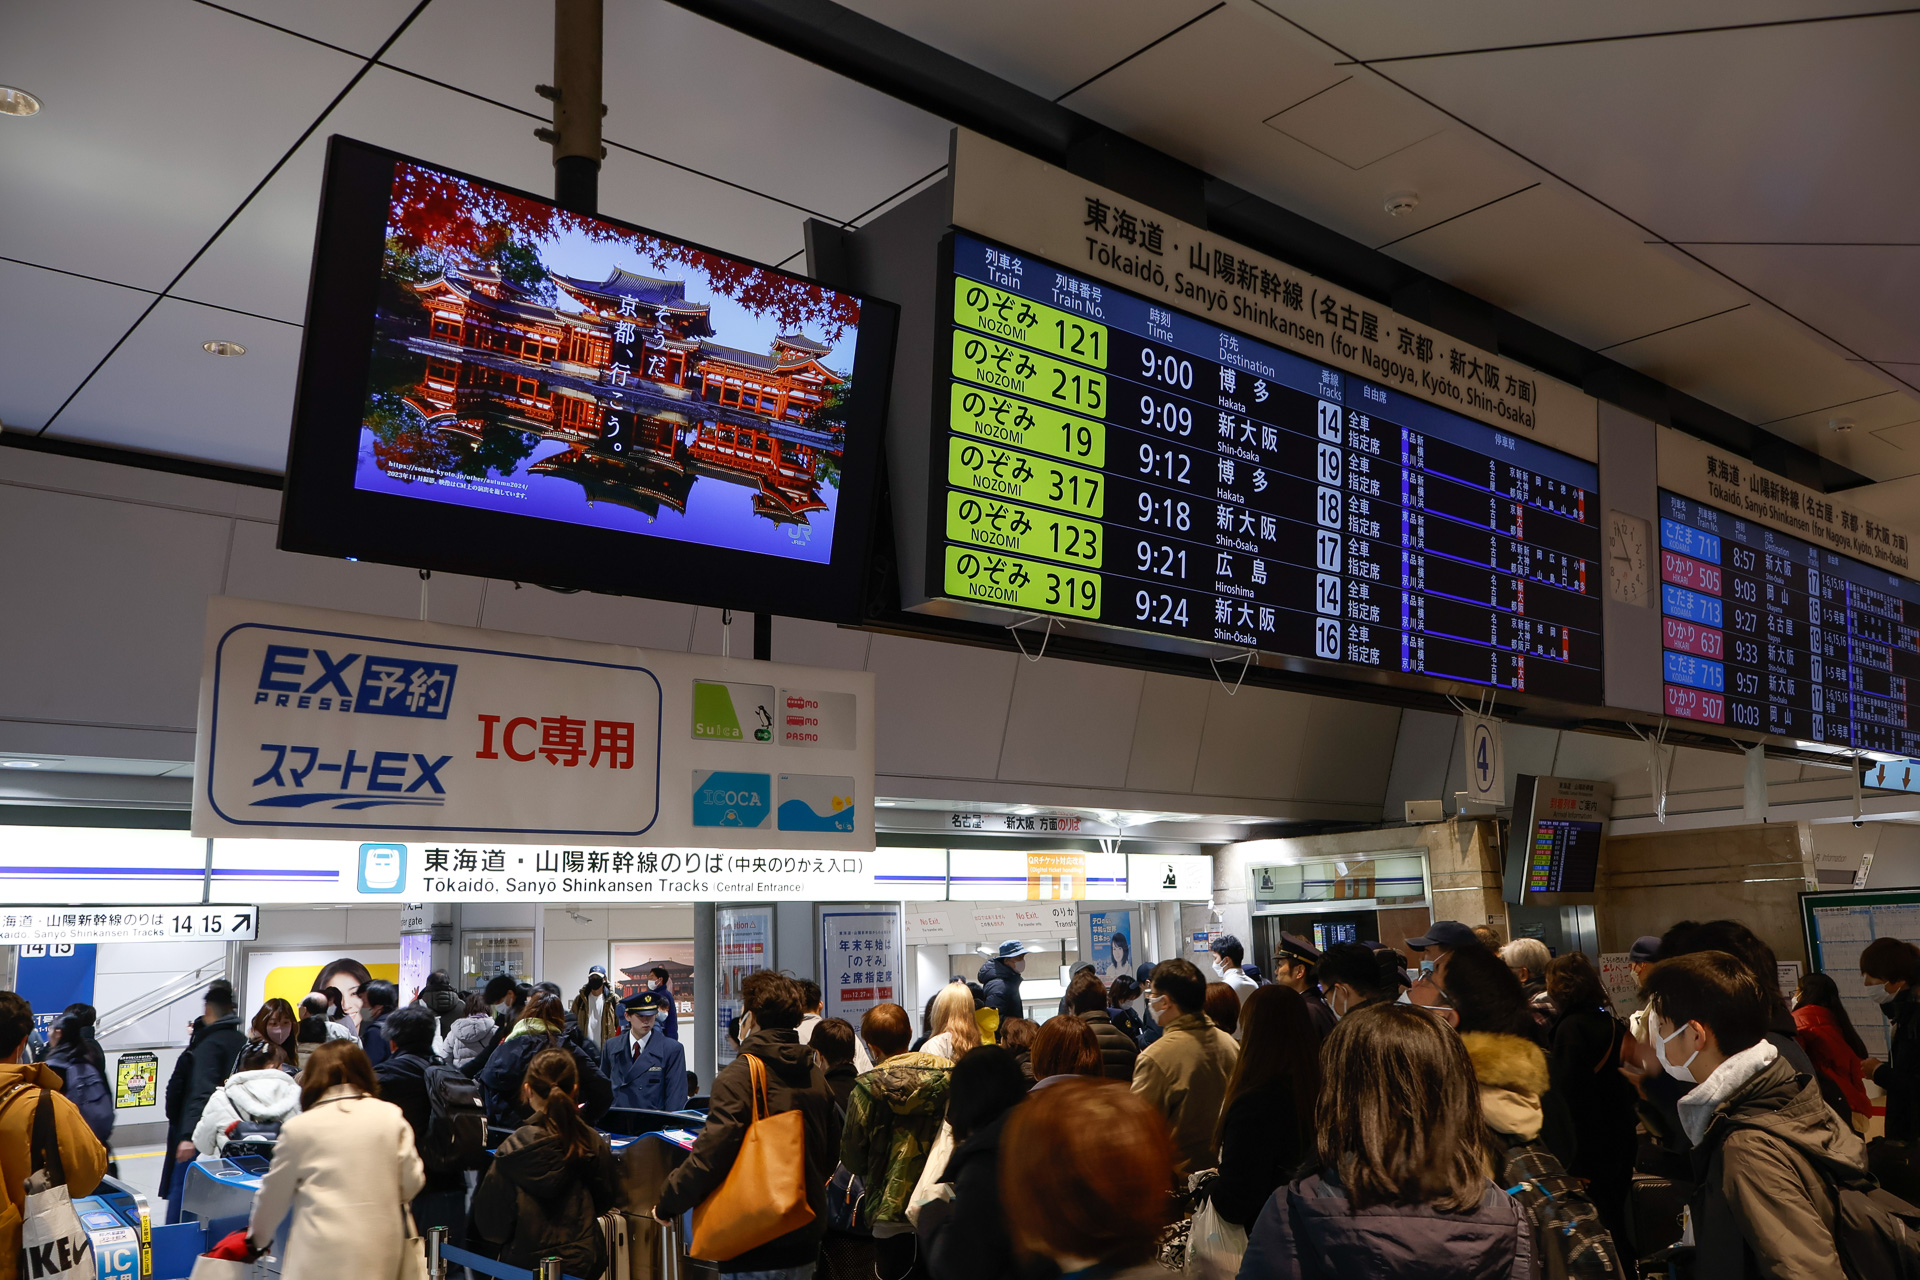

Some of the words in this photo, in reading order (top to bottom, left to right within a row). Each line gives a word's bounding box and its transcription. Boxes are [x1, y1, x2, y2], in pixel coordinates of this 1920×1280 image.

[985, 248, 1023, 276] 列車名
[987, 265, 1020, 290] Train
[1055, 274, 1102, 302] 列車番号
[966, 287, 1039, 328] のぞみ
[1052, 288, 1082, 312] Train
[1086, 300, 1106, 319] No.
[978, 315, 1027, 341] NOZOMI
[1150, 307, 1171, 328] 時刻
[648, 305, 671, 378] そうだ
[1055, 319, 1100, 361] 121
[1085, 237, 1169, 292] Tōkaidō,
[1174, 272, 1228, 312] Sanyō
[1233, 289, 1325, 349] Shinkansen
[1331, 331, 1357, 358] (for
[1362, 346, 1418, 386] Nagoya,
[1422, 373, 1464, 404] Kyōto,
[1467, 387, 1537, 431] Shin-Ōsaka)
[1147, 321, 1174, 343] Time
[1219, 332, 1239, 352] 行先
[964, 339, 1037, 380] のぞみ
[1141, 347, 1193, 390] 9:00
[1219, 347, 1275, 378] Destination
[607, 294, 639, 452] 京都、行こう。
[976, 368, 1025, 393] NOZOMI
[1218, 365, 1269, 403] 博多
[1051, 368, 1101, 410] 215
[1318, 382, 1342, 401] Tracks
[1363, 385, 1387, 404] 自由席
[962, 392, 1036, 431] のぞみ
[1140, 395, 1193, 437] 9:09
[1218, 395, 1246, 413] Hakata
[974, 420, 1023, 445] NOZOMI
[1217, 411, 1278, 452] 新大阪
[1319, 405, 1340, 439] 14
[1348, 411, 1370, 432] 全車
[1061, 423, 1093, 457] 19
[1217, 441, 1260, 463] Shin-Ōsaka
[1348, 430, 1380, 455] 指定席
[1495, 433, 1516, 451] 停車駅
[960, 445, 1034, 483] のぞみ
[1138, 443, 1191, 485] 9:12
[1217, 457, 1269, 493] 博多
[1319, 448, 1340, 482] 19
[1348, 452, 1370, 474] 全車
[972, 474, 1022, 497] NOZOMI
[1048, 469, 1099, 509] 317
[1216, 487, 1245, 504] Hakata
[1348, 471, 1380, 497] 指定席
[958, 499, 1033, 535] のぞみ
[1137, 491, 1191, 532] 9:18
[1319, 491, 1340, 525] 18
[1348, 495, 1370, 516] 全車
[788, 523, 813, 541] JR
[1216, 503, 1277, 543] 新大阪
[1348, 514, 1380, 538] 指定席
[1666, 522, 1693, 545] こだま
[1744, 498, 1768, 521] Sanyō
[1769, 504, 1810, 533] Shinkansen
[1826, 528, 1852, 551] Nagoya,
[970, 528, 1020, 550] NOZOMI
[1049, 522, 1098, 561] 123
[1215, 533, 1259, 553] Shin-Ōsaka
[1318, 534, 1339, 567] 17
[1348, 537, 1370, 558] 全車
[1698, 535, 1718, 559] 711
[956, 553, 1031, 589] のぞみ
[1136, 540, 1187, 579] 9:21
[1215, 551, 1268, 585] 広島
[1348, 557, 1380, 581] 指定席
[1666, 555, 1694, 576] ひかり
[1733, 547, 1755, 571] 8:57
[1765, 554, 1792, 577] 新大阪
[1215, 580, 1255, 599] Hiroshima
[1348, 580, 1370, 601] 全車
[1699, 567, 1720, 591] 505
[1734, 578, 1757, 602] 9:03
[968, 582, 1018, 603] NOZOMI
[1045, 573, 1097, 611] 319
[1318, 578, 1339, 611] 14
[1668, 588, 1694, 609] こだま
[1767, 583, 1789, 606] 岡山
[1135, 589, 1189, 628] 9:24
[1214, 597, 1276, 633] 新大阪
[1348, 600, 1380, 623] 指定席
[1700, 599, 1720, 624] 713
[1348, 623, 1370, 643] 全車
[1667, 621, 1695, 642] ひかり
[1735, 610, 1757, 633] 9:27
[1767, 614, 1793, 636] 名古屋
[1214, 627, 1257, 646] Shin-Ōsaka
[1317, 622, 1339, 655] 16
[1701, 632, 1721, 655] 637
[1348, 643, 1380, 665] 指定席
[1736, 640, 1758, 664] 9:33
[1669, 654, 1696, 675] こだま
[1701, 664, 1722, 687] 715
[1737, 672, 1758, 694] 9:57
[254, 691, 353, 714] PRESS
[1669, 688, 1696, 708] ひかり
[1702, 697, 1723, 719] 507
[1732, 702, 1760, 726] 10:03
[475, 713, 635, 770] IC専用
[695, 723, 740, 737] Suica
[786, 732, 818, 742] PASMO
[252, 743, 454, 795] スマートEX
[1476, 736, 1489, 782] 4
[703, 789, 762, 807] ICOCA
[423, 876, 500, 895] Tōkaidō,
[506, 876, 557, 895] Sanyō
[562, 877, 653, 893] Shinkansen
[659, 878, 709, 892] Tracks
[713, 882, 754, 893] (Central
[70, 929, 129, 938] Shinkansen
[133, 927, 165, 937] Tracks
[172, 915, 193, 934] 14
[201, 915, 222, 934] 15
[408, 916, 423, 928] gate
[839, 938, 891, 952] 年末年始は
[848, 954, 887, 968] 「のぞみ」
[840, 970, 892, 985] 全席指定席
[104, 1248, 132, 1274] IC
